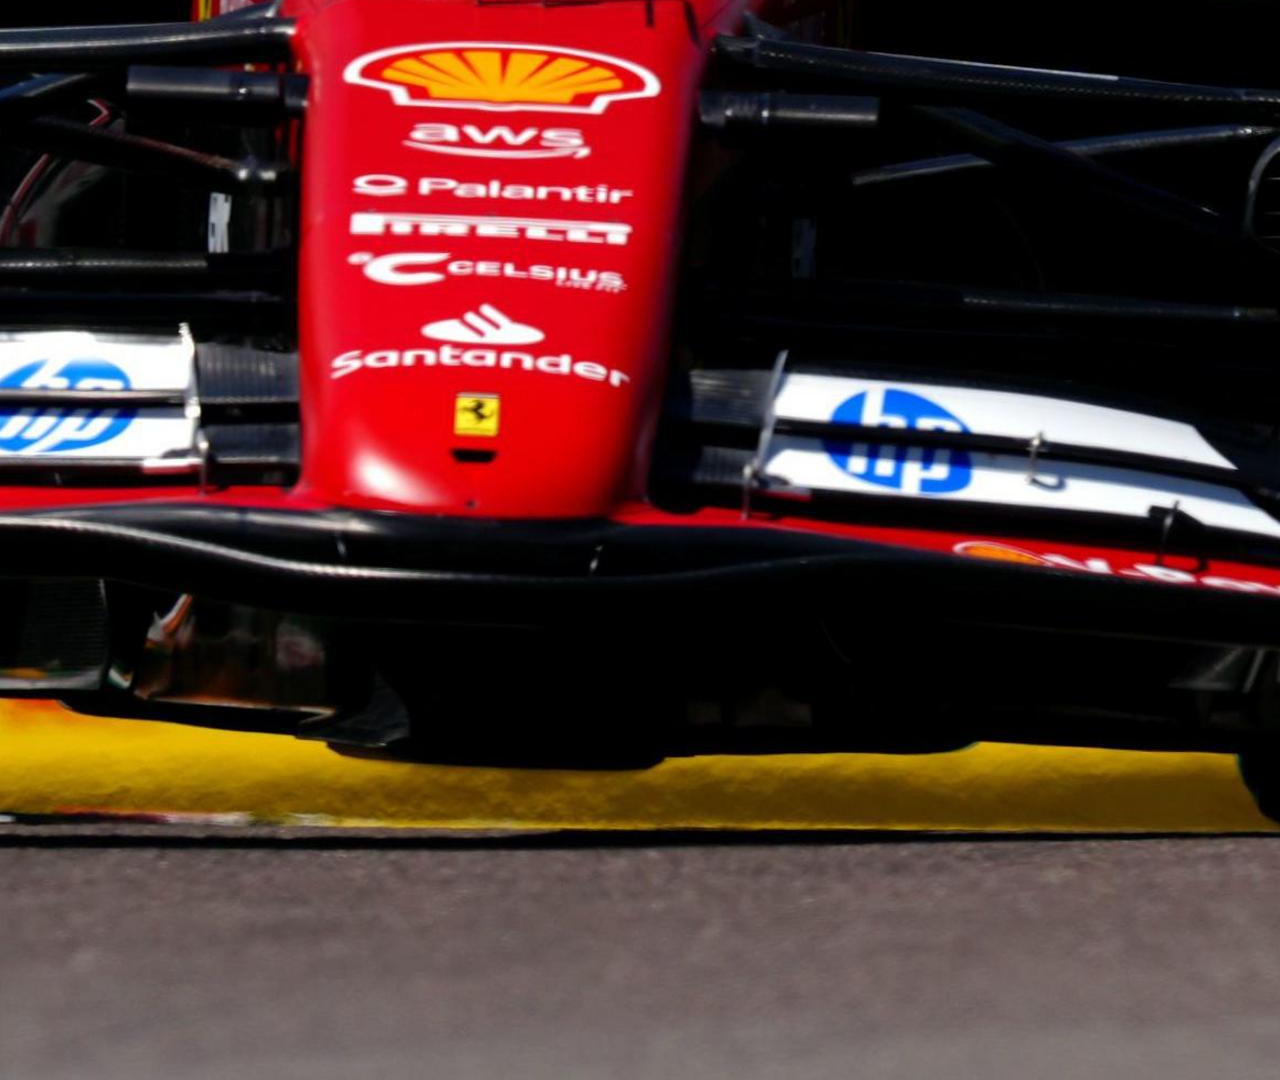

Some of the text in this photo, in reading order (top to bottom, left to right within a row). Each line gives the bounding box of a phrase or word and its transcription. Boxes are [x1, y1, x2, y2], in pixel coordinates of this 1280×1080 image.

[406, 123, 588, 149] aws
[418, 177, 633, 206] Palantir
[350, 213, 633, 246] PIRELLI
[447, 260, 624, 288] CELSIUS
[331, 346, 631, 390] Santander
[823, 387, 972, 494] hp
